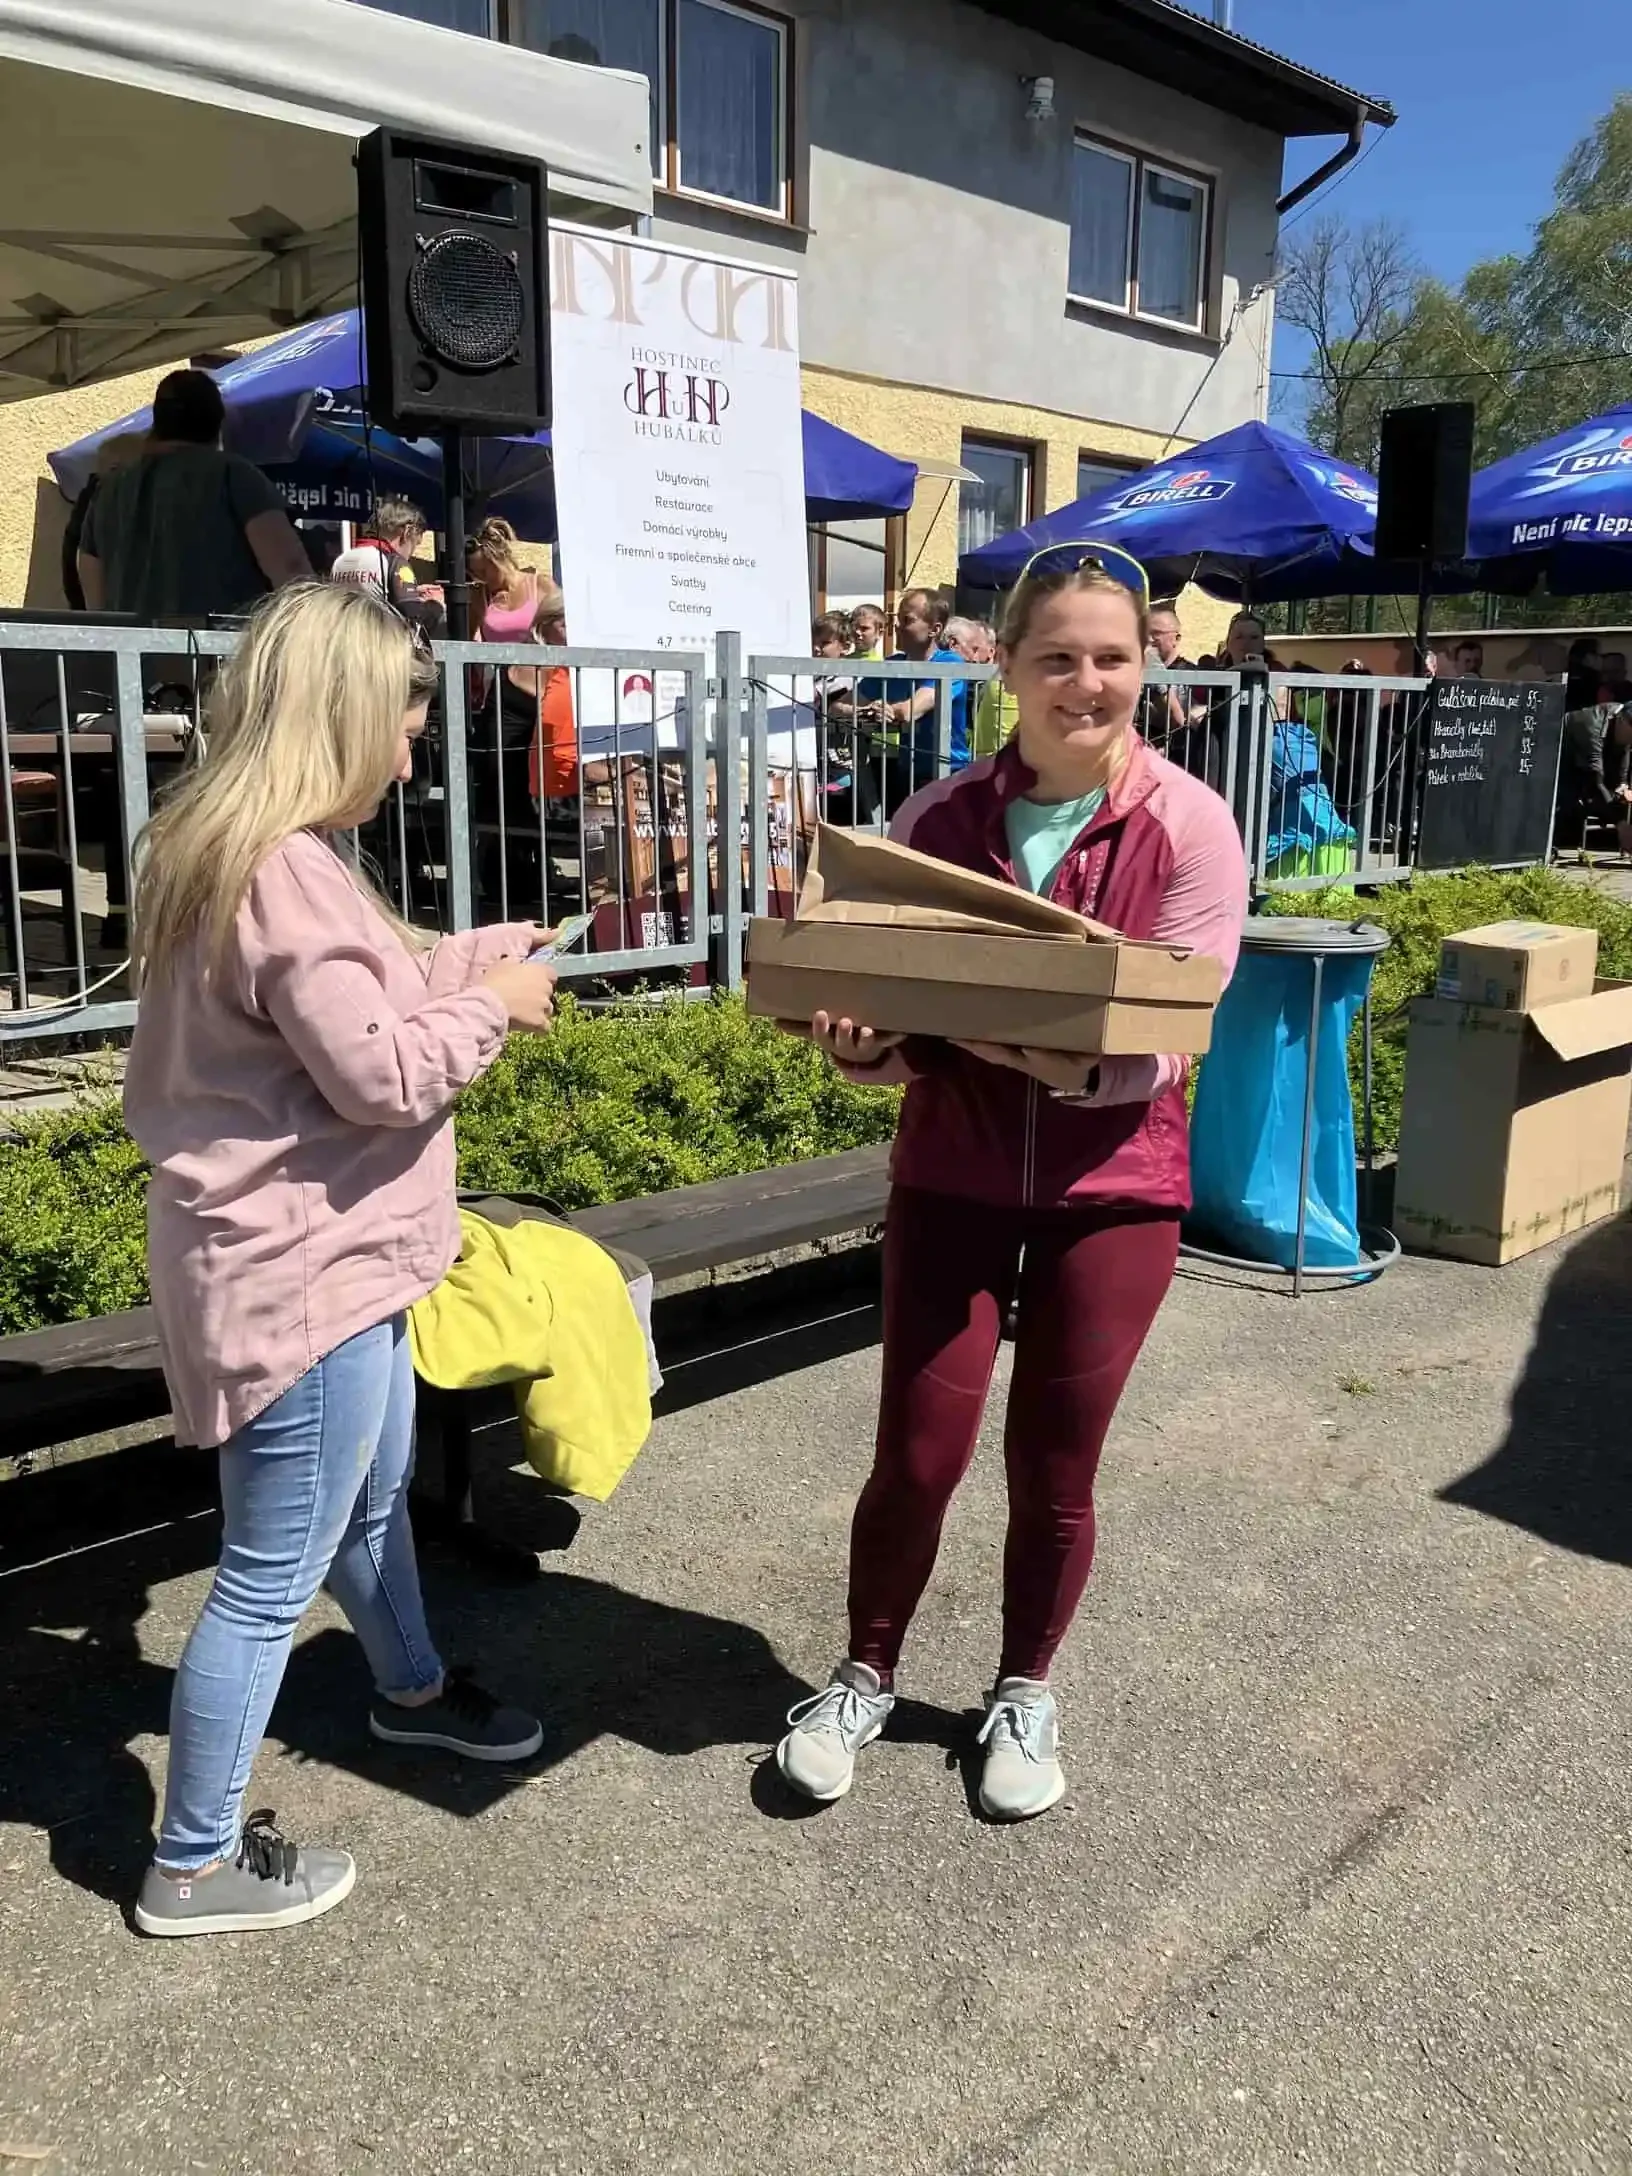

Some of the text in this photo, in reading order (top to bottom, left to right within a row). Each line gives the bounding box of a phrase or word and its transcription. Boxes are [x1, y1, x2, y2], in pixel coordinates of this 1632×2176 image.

[631, 346, 722, 374] HOSTINEC
[655, 469, 711, 489] Ubytování
[654, 495, 714, 513] Restaurace
[1128, 485, 1217, 506] BIRELL
[642, 520, 728, 543] Domácí výrobky
[1512, 517, 1560, 545] Není
[1562, 513, 1592, 534] nic
[615, 544, 757, 568] Firemní a společenské akce
[671, 575, 707, 591] Svatby
[668, 600, 713, 617] Catering
[656, 636, 673, 649] 4,7
